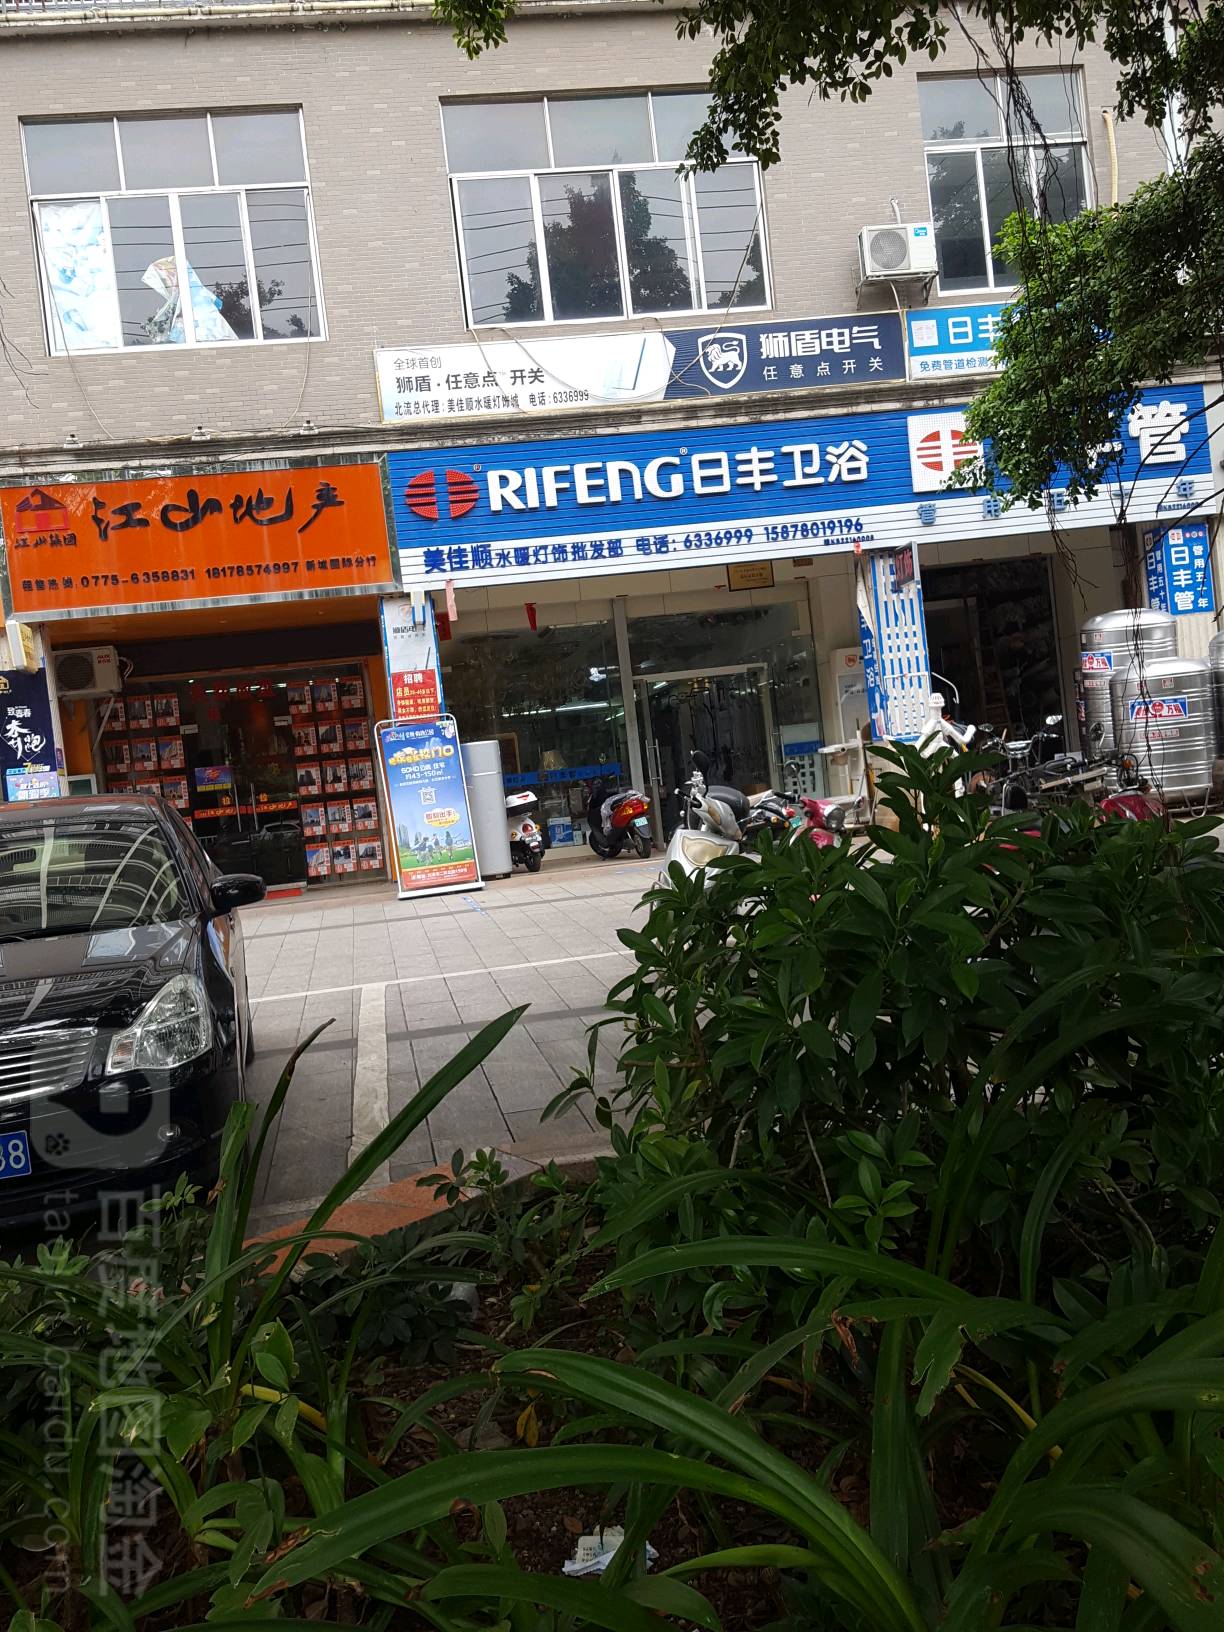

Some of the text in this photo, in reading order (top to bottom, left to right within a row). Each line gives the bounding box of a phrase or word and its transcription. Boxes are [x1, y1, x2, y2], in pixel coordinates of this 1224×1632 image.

[394, 356, 442, 371] 全球首创
[760, 325, 881, 359] 狮盾电气
[509, 368, 545, 386] 开关
[763, 357, 884, 380] 任意点开关
[486, 439, 870, 513] RIFENG 日丰卫浴
[90, 480, 344, 542] 江山地产
[423, 539, 624, 574] 美佳顺水暖灯饰批发部
[764, 517, 863, 542] 15878019196
[1170, 546, 1195, 611] 日丰管
